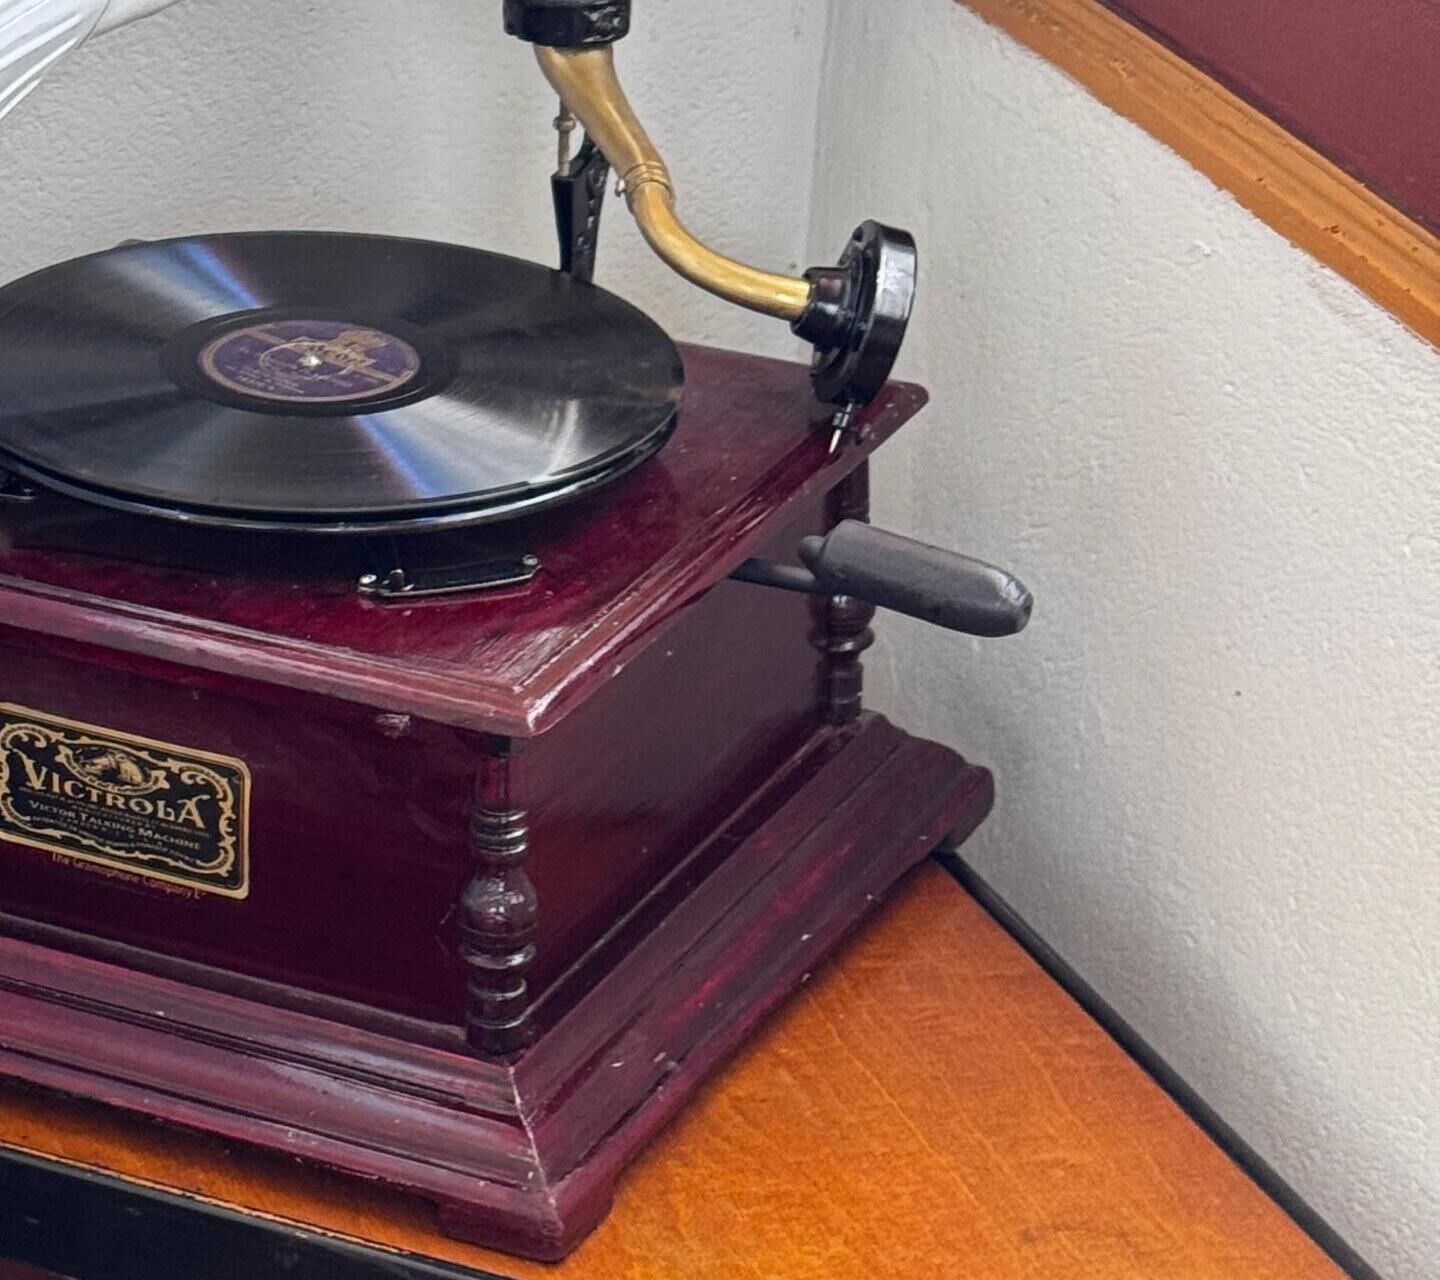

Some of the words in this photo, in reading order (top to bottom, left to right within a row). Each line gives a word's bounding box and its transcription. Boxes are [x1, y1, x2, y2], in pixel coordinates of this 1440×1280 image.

[11, 748, 211, 829] VICTROLA
[28, 799, 77, 820] VICTOR
[79, 812, 136, 833] TALKING
[138, 827, 201, 851] MACHINE
